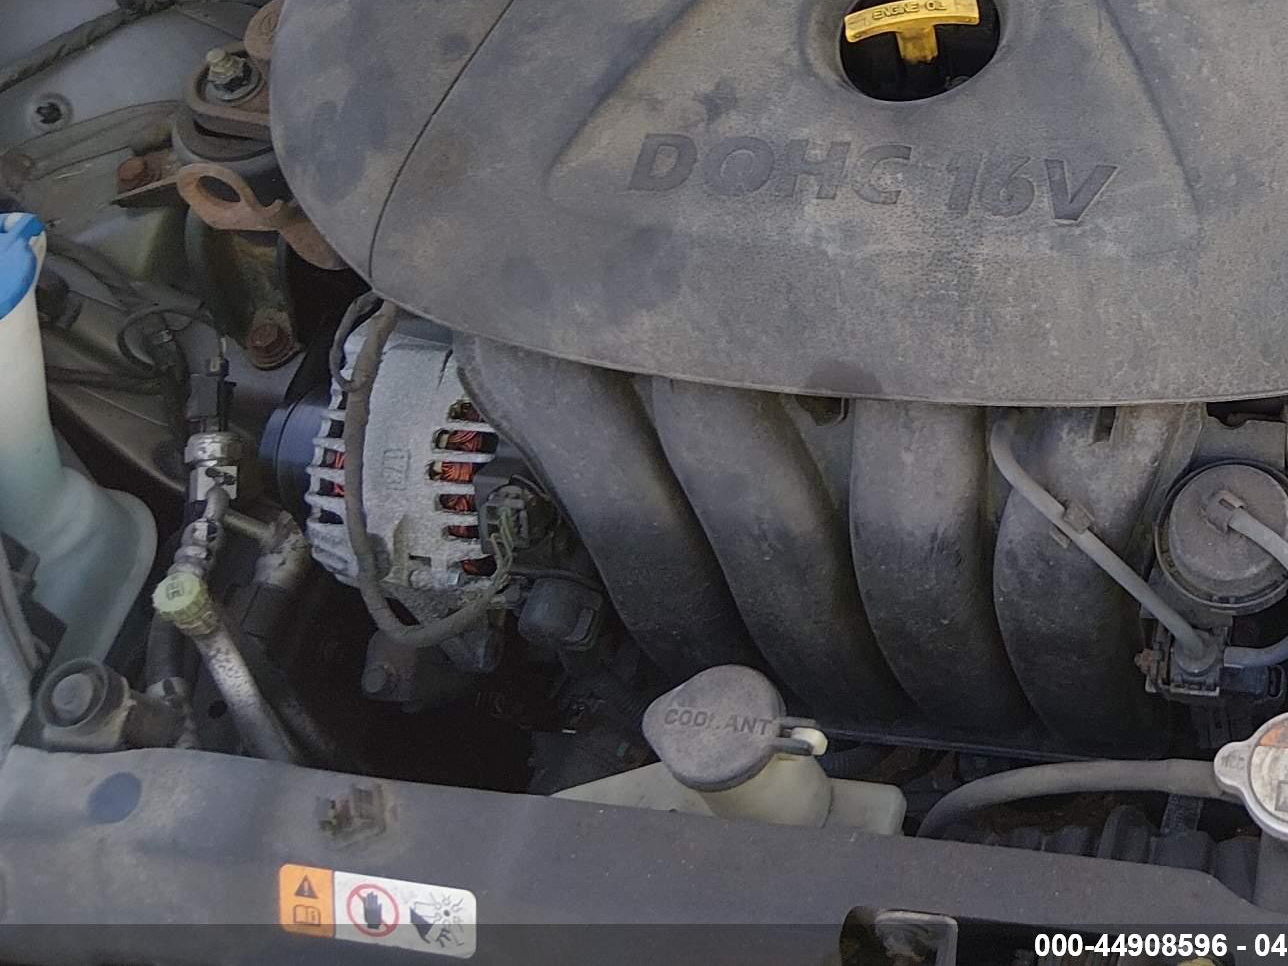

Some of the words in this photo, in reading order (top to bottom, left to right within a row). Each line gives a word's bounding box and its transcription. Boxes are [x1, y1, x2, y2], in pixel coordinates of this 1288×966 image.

[871, 2, 920, 21] ENGINE
[924, 0, 948, 12] OIL
[626, 131, 912, 205] DOHC
[944, 150, 1120, 225] 16V
[664, 708, 773, 736] COOLANT
